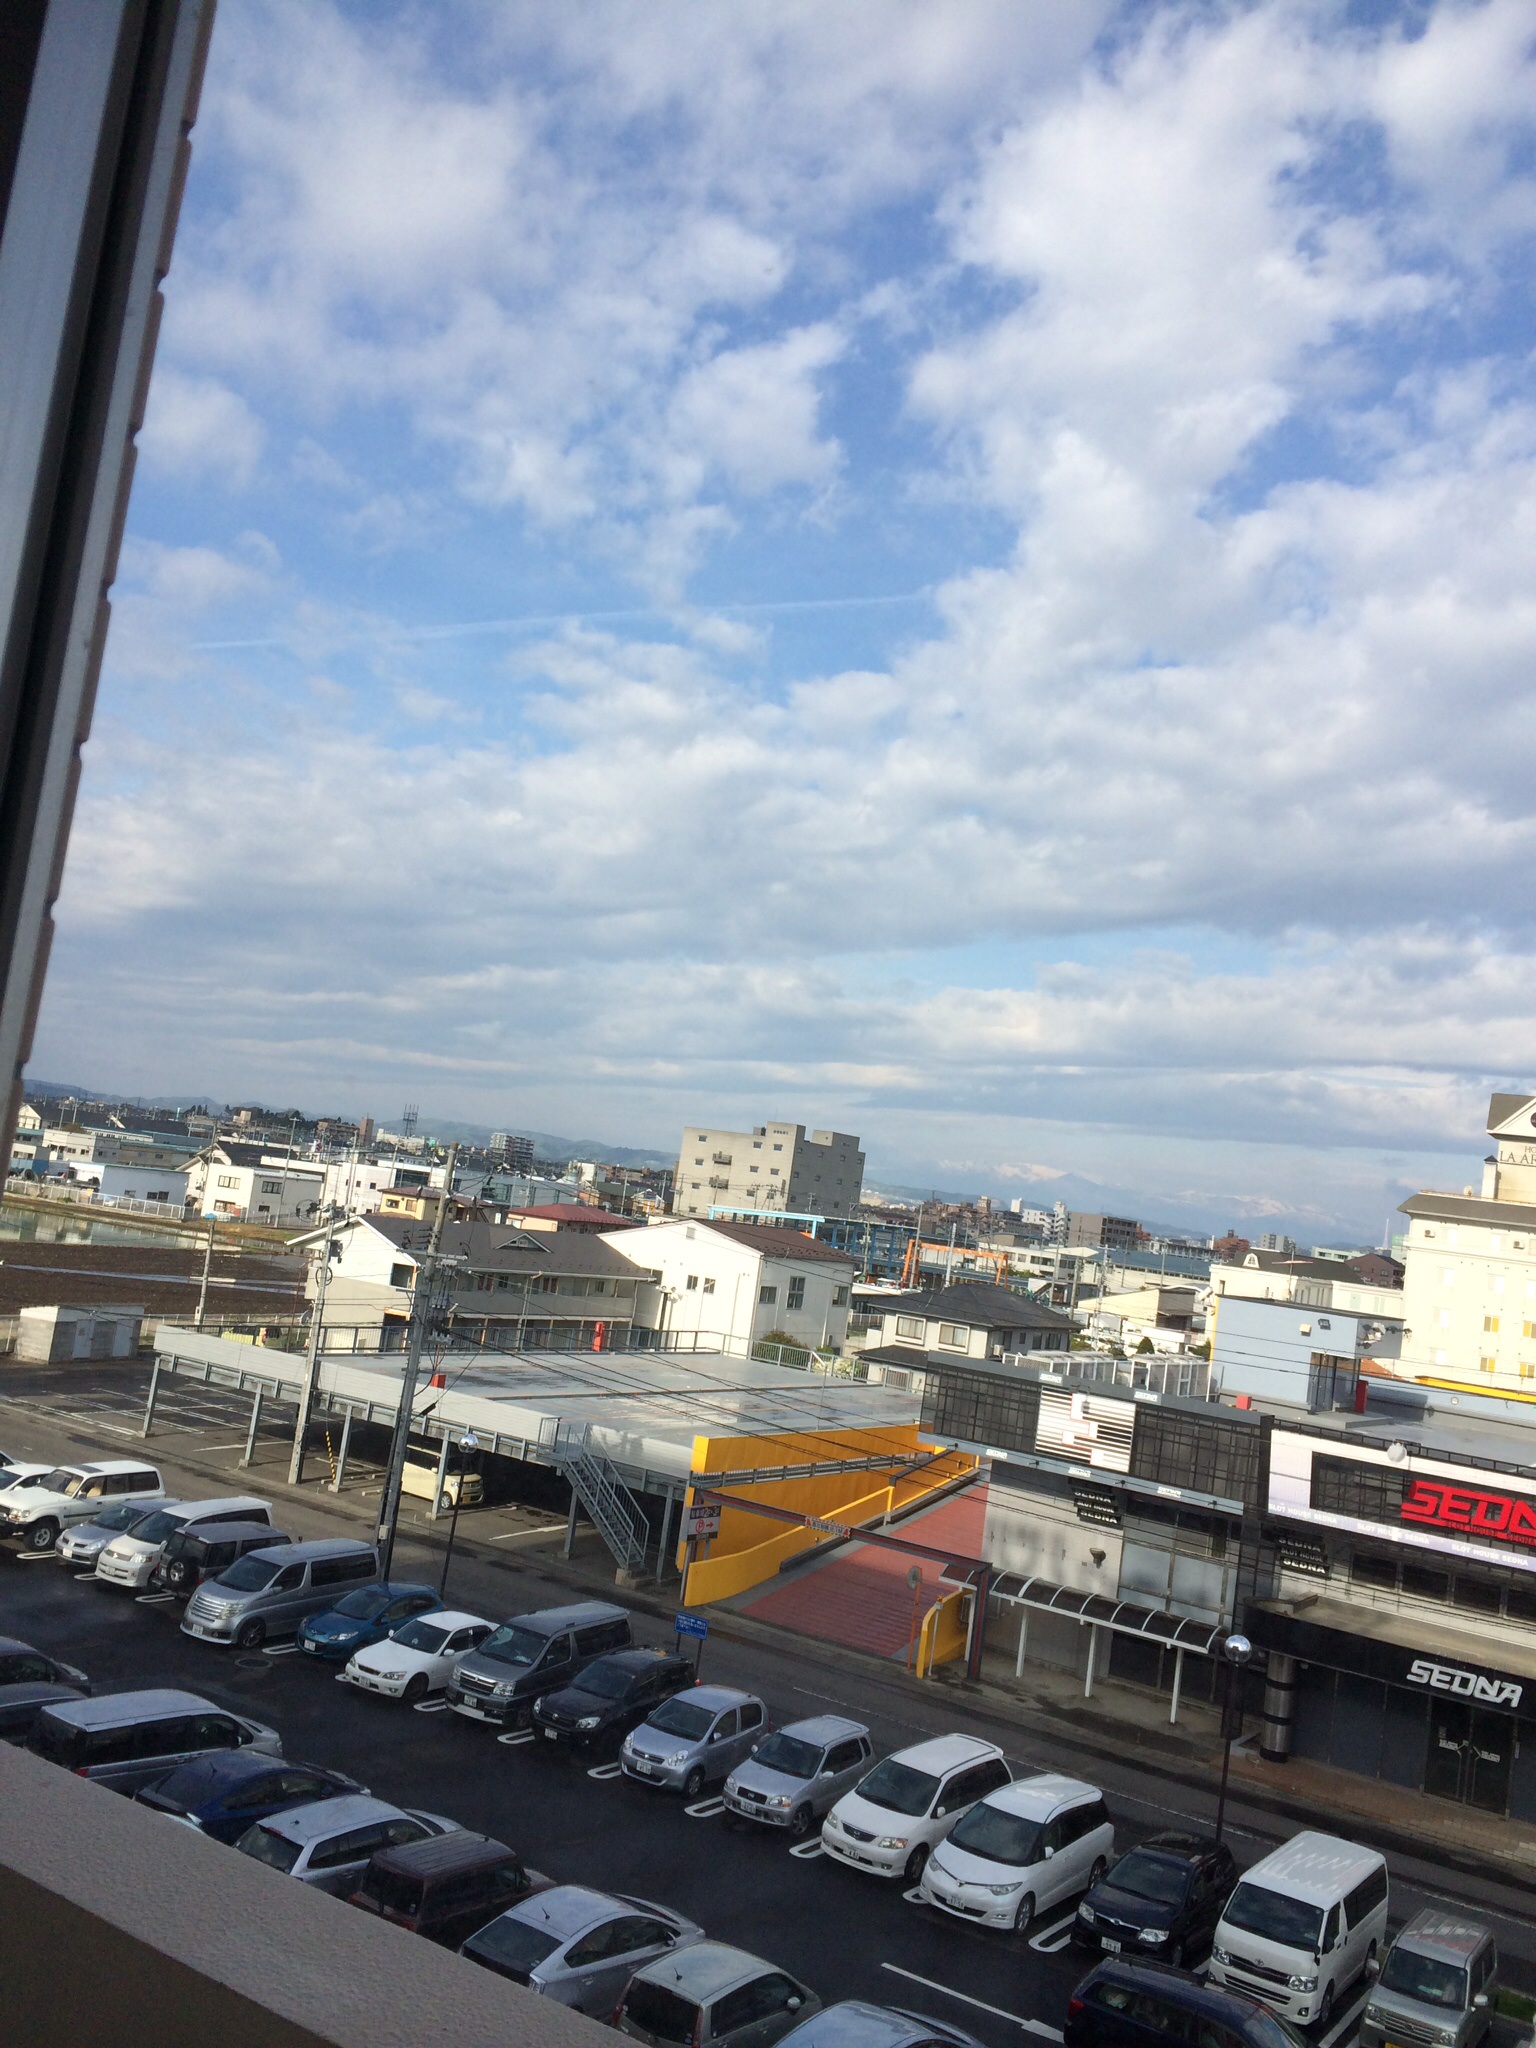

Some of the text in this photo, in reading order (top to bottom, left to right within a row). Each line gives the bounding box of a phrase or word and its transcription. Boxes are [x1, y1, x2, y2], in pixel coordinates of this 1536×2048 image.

[1500, 1151, 1516, 1163] LA
[1451, 1543, 1528, 1566] SLOT HOUSE SEDNA
[1283, 1557, 1326, 1574] SEDNA
[1406, 1659, 1523, 1708] SEDNA
